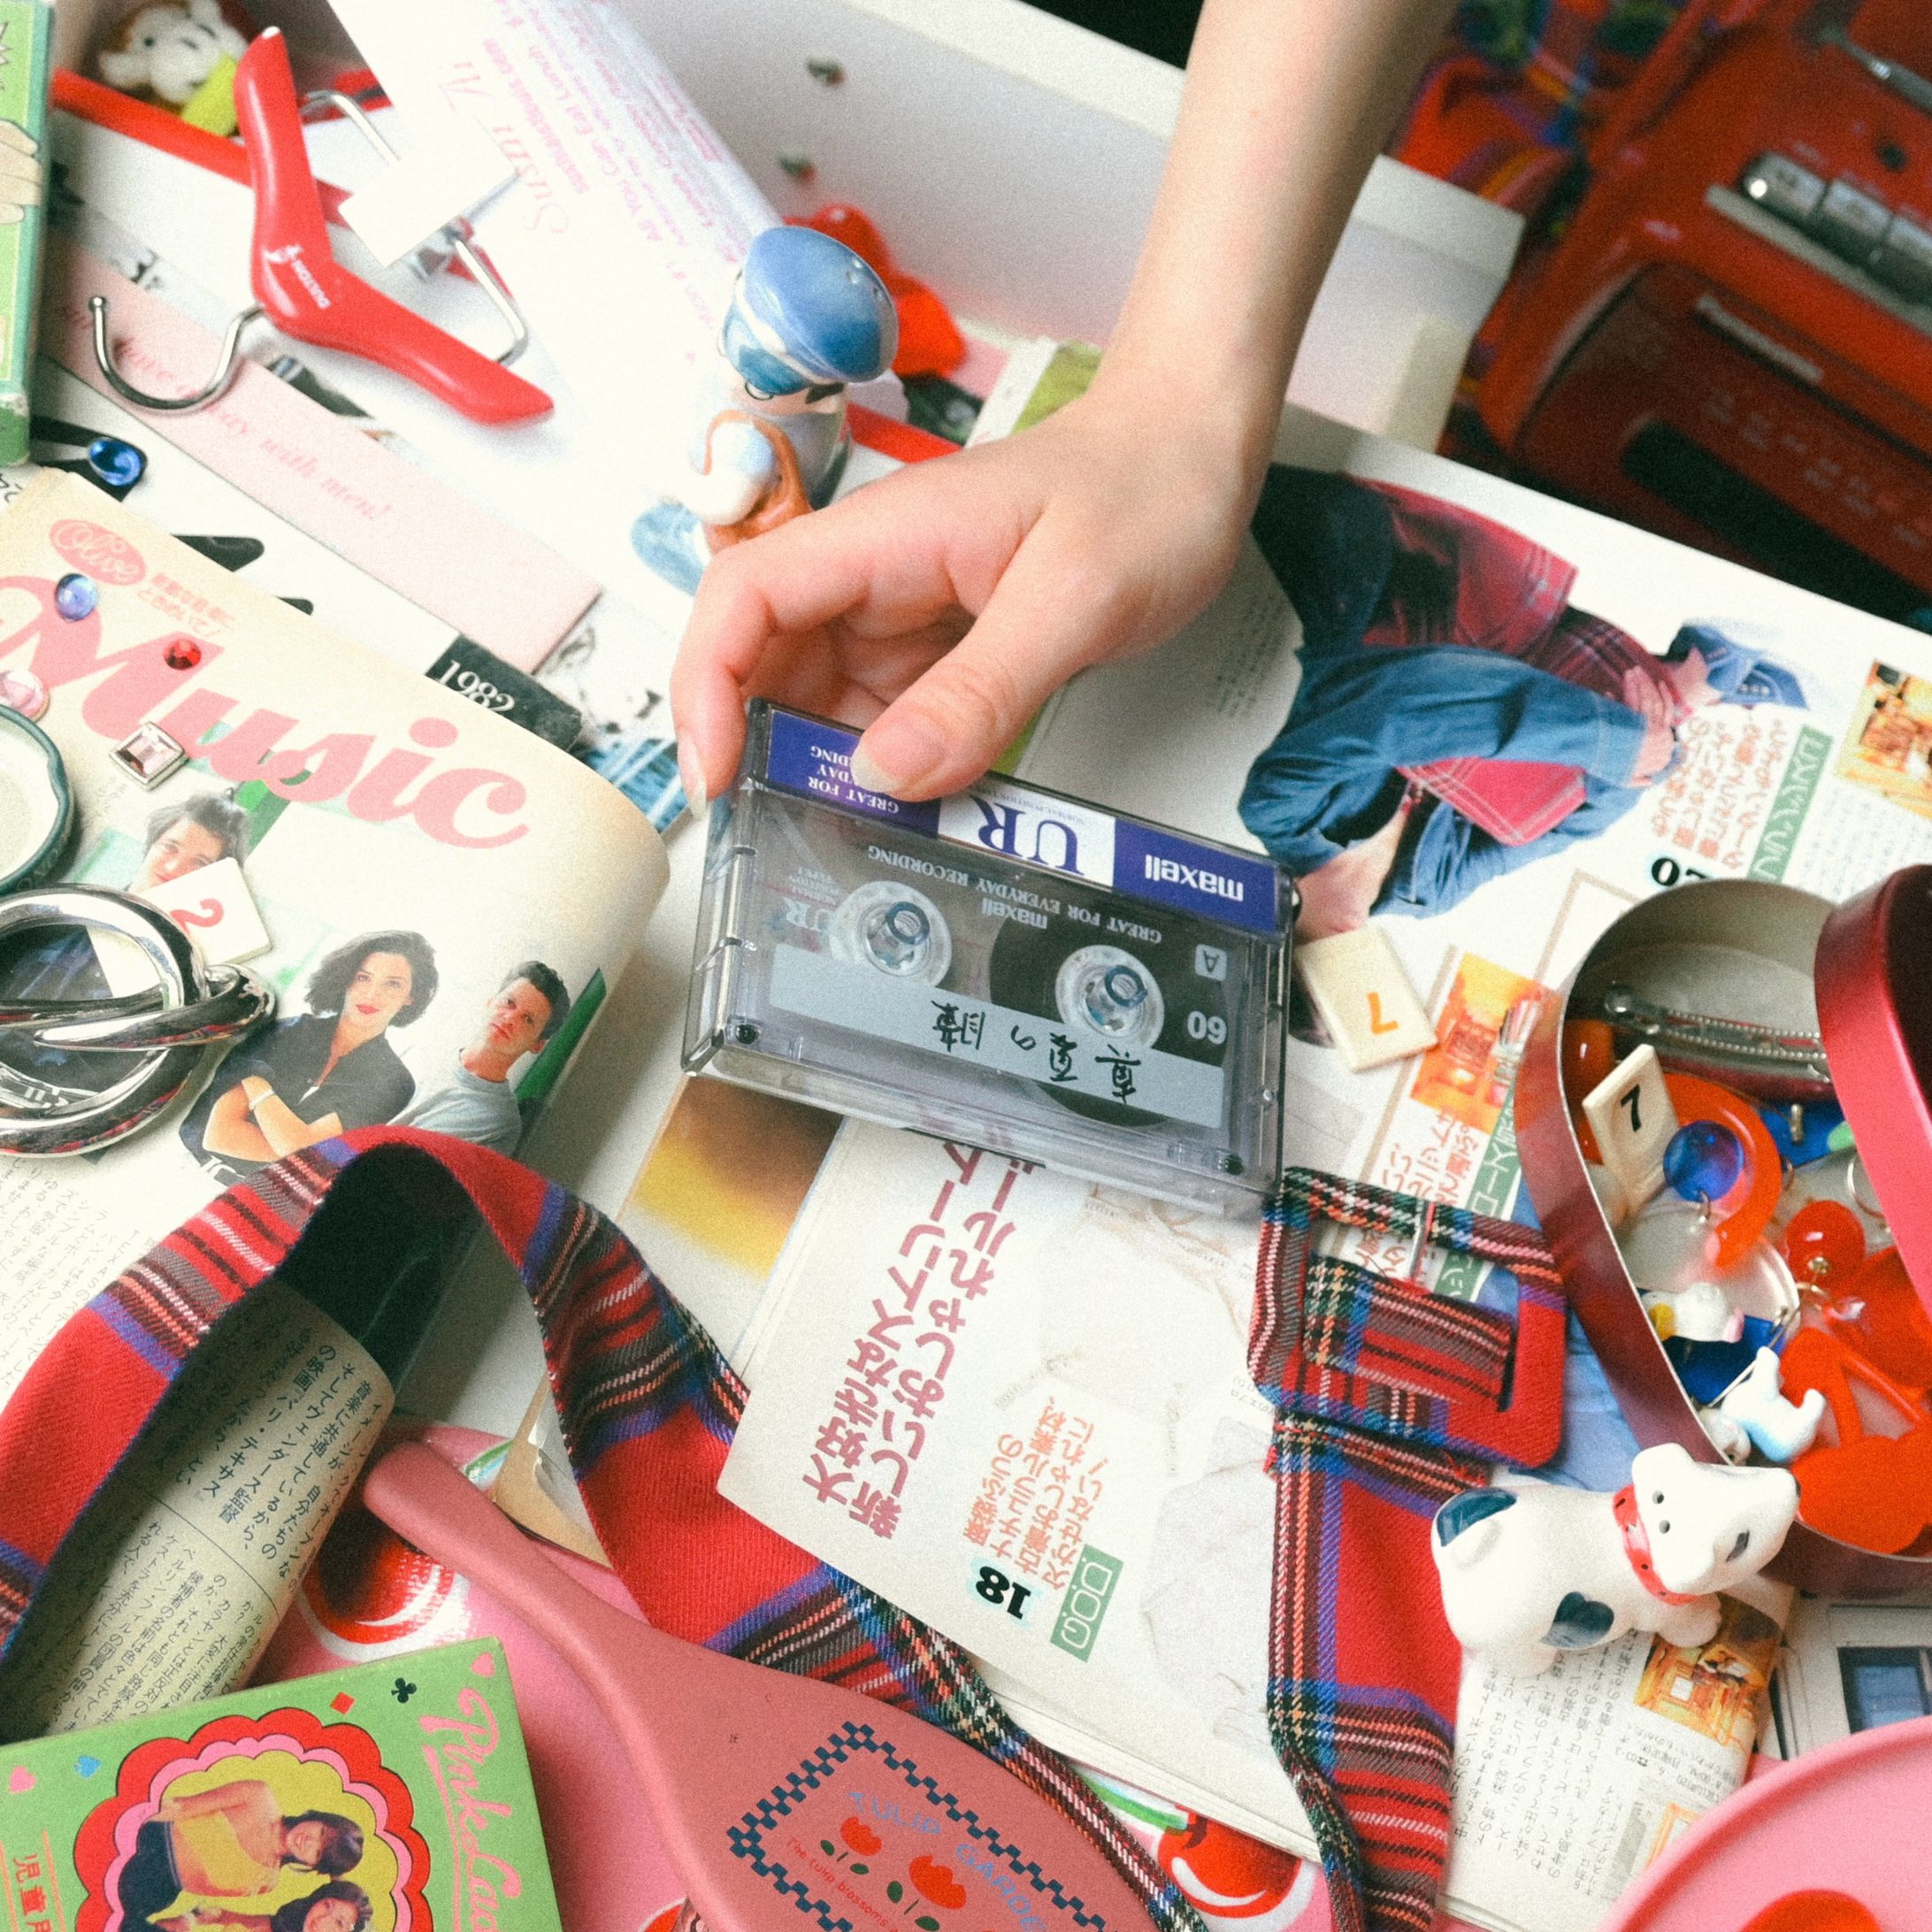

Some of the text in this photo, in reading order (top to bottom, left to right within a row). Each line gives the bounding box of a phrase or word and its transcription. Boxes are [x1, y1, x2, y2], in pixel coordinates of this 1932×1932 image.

[0, 576, 530, 849] Music
[433, 660, 515, 712] 1982
[809, 775, 899, 813] GREAT FOR
[978, 798, 1085, 877] UR
[868, 843, 1162, 944] GREAT FOR EVERYDAY RECORDING
[1146, 855, 1244, 901] maxell
[170, 898, 224, 938] 2
[982, 897, 1049, 931] maxell
[1203, 947, 1223, 971] A
[1187, 1009, 1228, 1046] 60
[1621, 1084, 1642, 1132] 7
[848, 1159, 1033, 1540] 新しいおしゃれルー
[220, 1362, 356, 1523] そしてヴェンダース監督
[243, 1380, 372, 1550] 音楽に共通しているから、
[975, 1565, 1031, 1621] 18
[1061, 1557, 1114, 1651] G.O.D.
[129, 1599, 231, 1716] カラヤンとは正反対の
[848, 1791, 941, 1834] TULIP
[786, 1836, 888, 1928] The tulip blossoms
